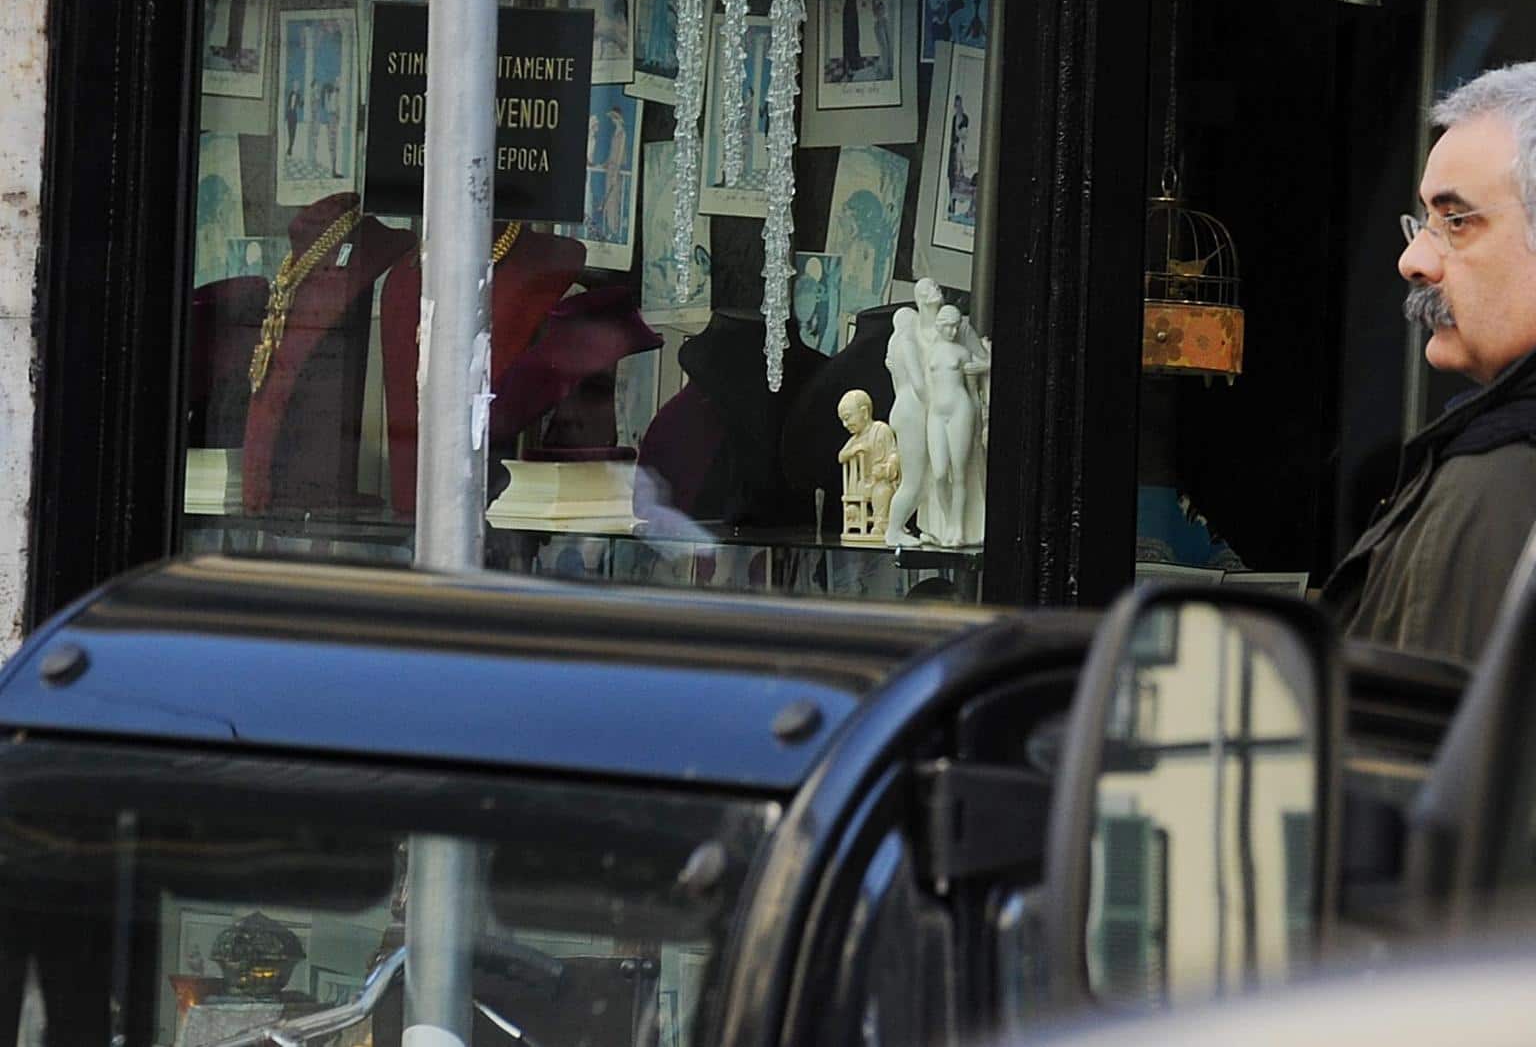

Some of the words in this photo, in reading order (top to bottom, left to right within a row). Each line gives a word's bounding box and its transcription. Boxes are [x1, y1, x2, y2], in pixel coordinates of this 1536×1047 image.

[387, 51, 428, 75] STIM
[497, 55, 576, 82] ITAMENTE
[398, 93, 425, 124] CO
